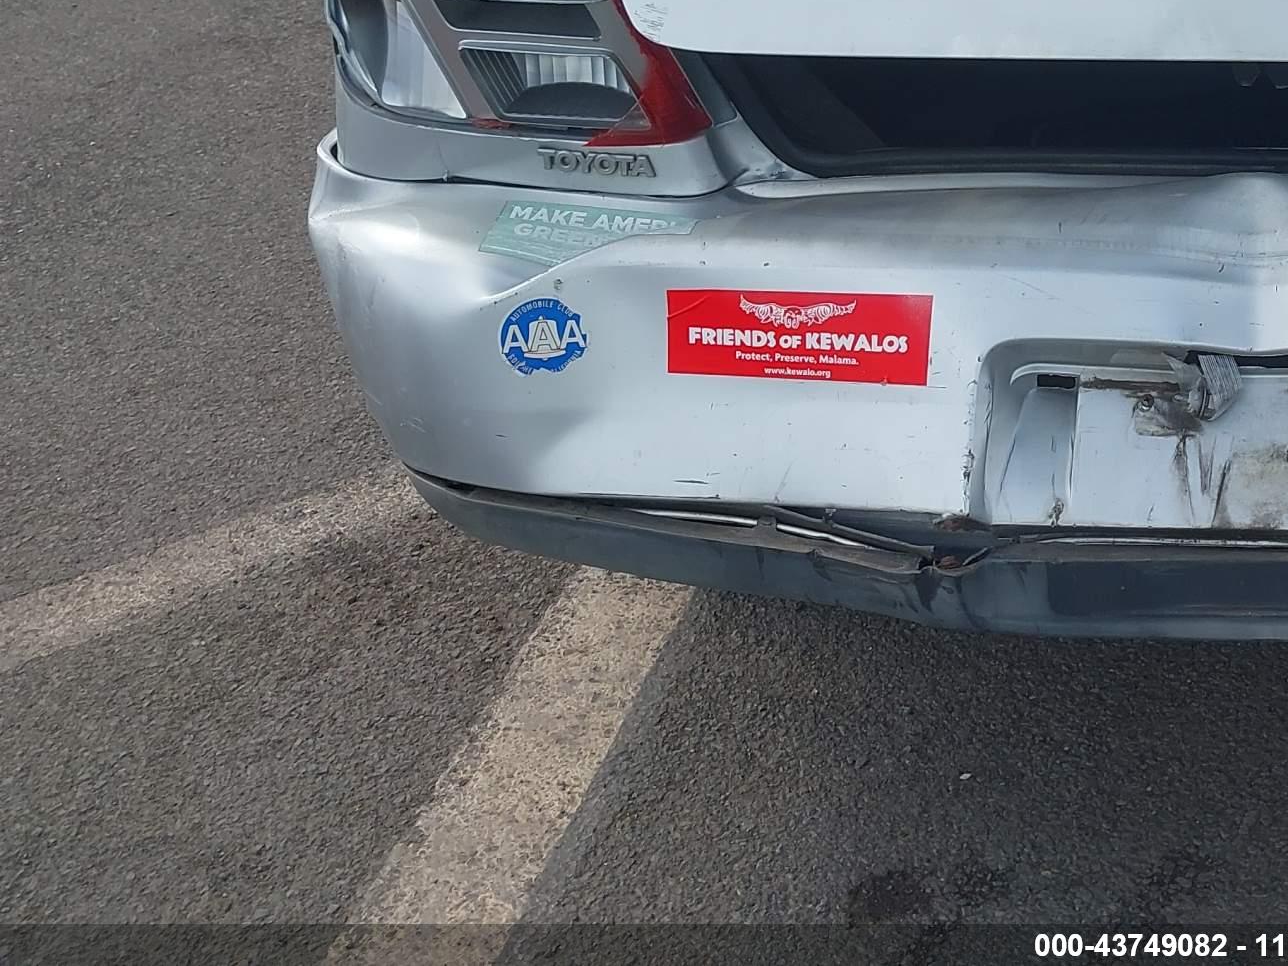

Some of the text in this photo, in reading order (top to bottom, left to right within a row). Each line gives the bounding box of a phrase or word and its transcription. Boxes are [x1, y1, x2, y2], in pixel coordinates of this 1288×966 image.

[537, 147, 657, 177] TOYOTA
[509, 206, 587, 227] MAKE
[510, 300, 553, 322] AUTOMOBILE
[503, 320, 586, 354] AAA
[688, 326, 776, 347] FRIENDS
[805, 333, 908, 353] KEWALOS
[735, 350, 859, 365] Protect, Preserve, Malama.
[764, 366, 831, 378] www.kewalo.org
